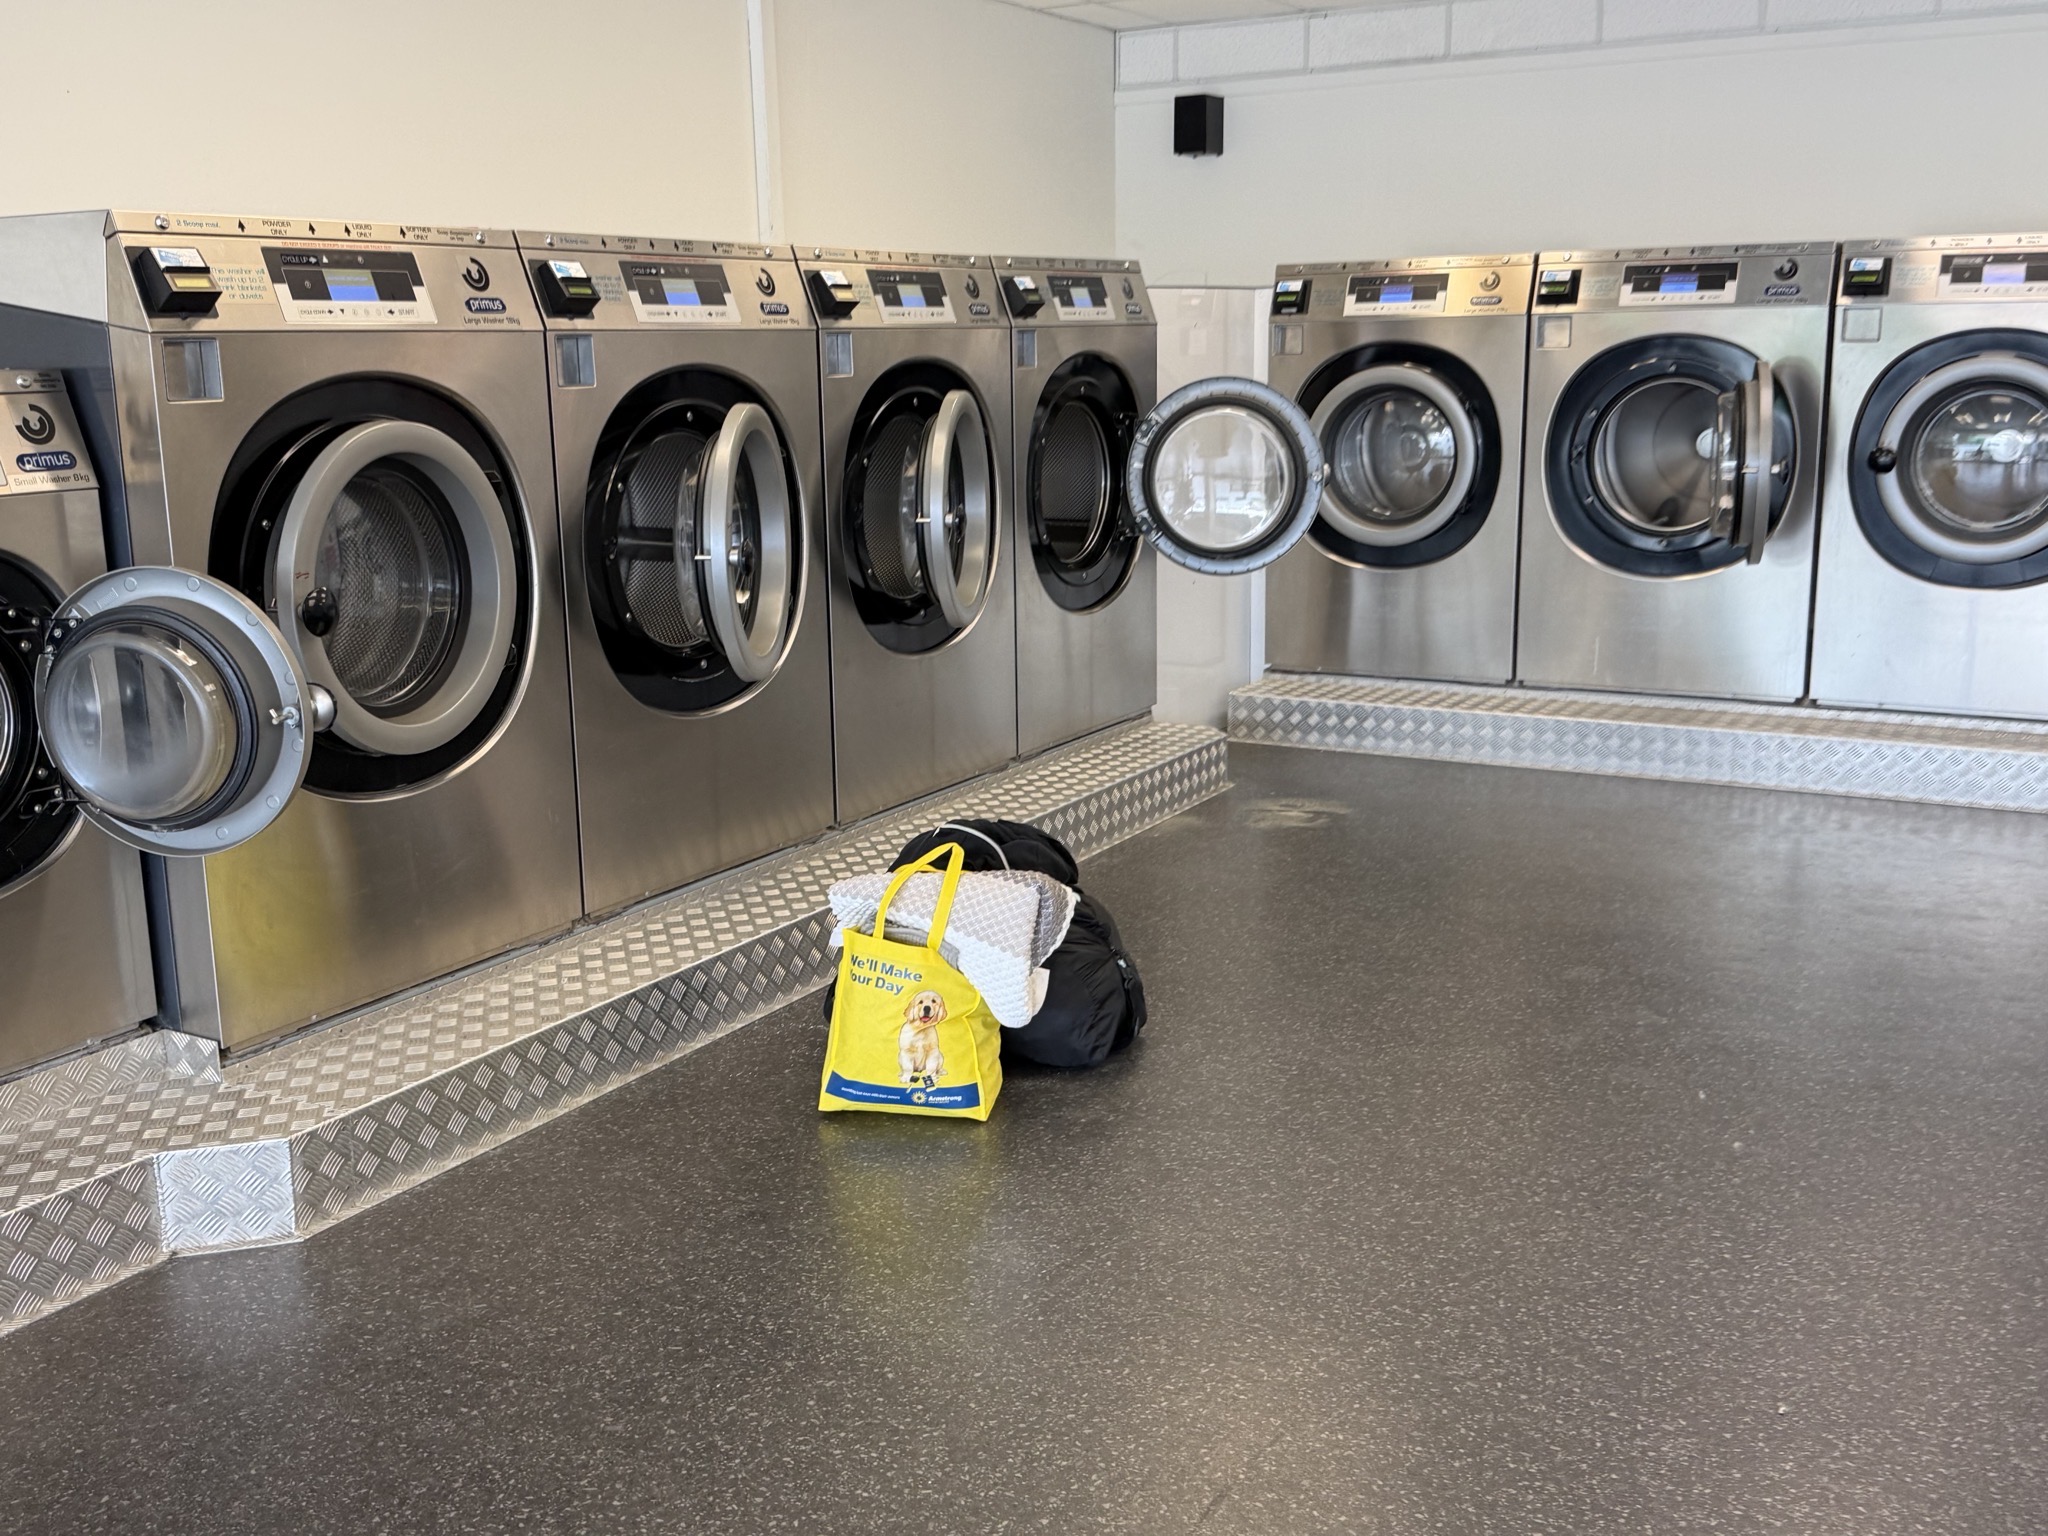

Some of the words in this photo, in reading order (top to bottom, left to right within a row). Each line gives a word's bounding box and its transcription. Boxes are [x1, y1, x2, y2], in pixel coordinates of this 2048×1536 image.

[261, 219, 292, 228] POWDER
[351, 222, 373, 231] LIQUID
[270, 228, 288, 236] ONLY
[413, 233, 429, 241] ONLY
[469, 298, 503, 313] primus
[463, 316, 481, 326] Large
[481, 316, 505, 325] Washer
[23, 452, 71, 470] primus
[13, 477, 37, 487] Small
[39, 474, 72, 485] Washer
[72, 473, 90, 483] 8kg
[850, 954, 878, 973] We'll
[880, 962, 923, 983] Make
[850, 968, 873, 986] our
[874, 976, 905, 996] Day
